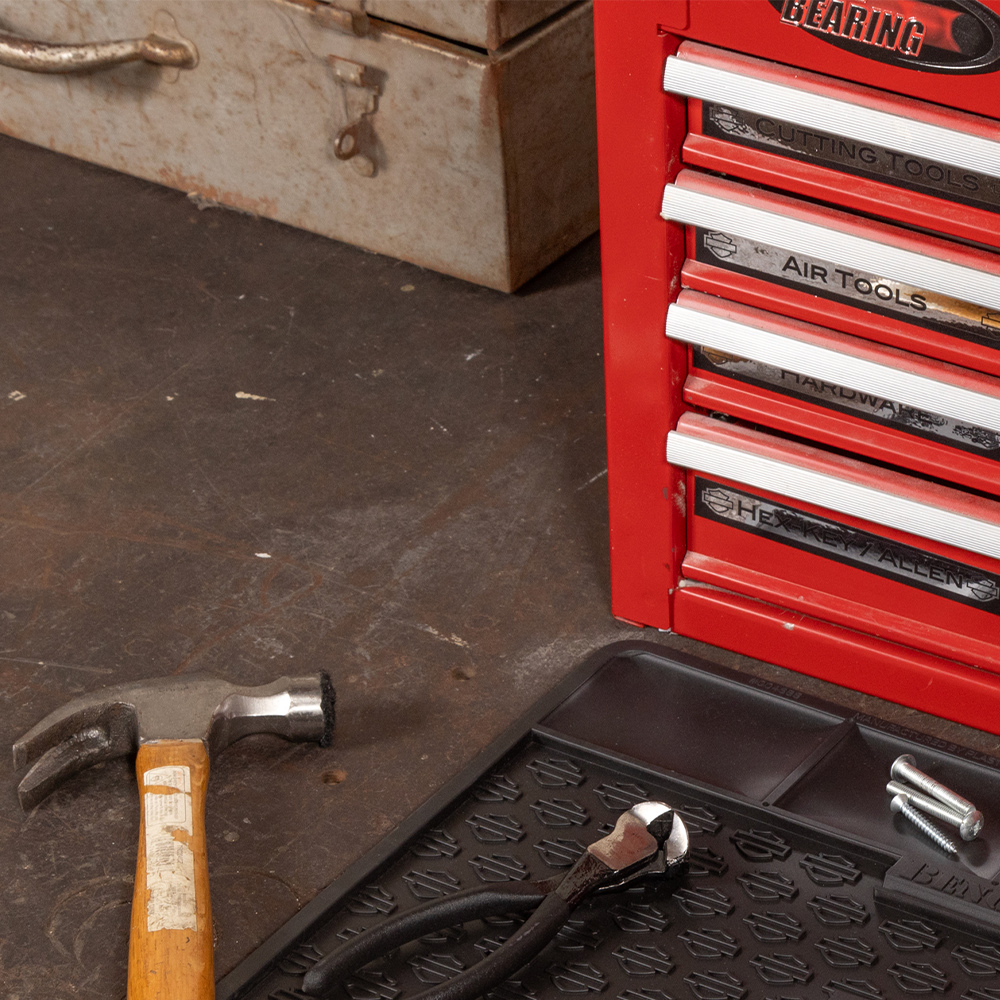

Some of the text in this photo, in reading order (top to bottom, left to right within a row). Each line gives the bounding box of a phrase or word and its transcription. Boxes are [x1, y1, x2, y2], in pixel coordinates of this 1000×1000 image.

[780, 0, 926, 57] BEARING
[756, 117, 979, 192] CUTTING TOOLS
[782, 256, 927, 312] AIR TOOLS
[737, 502, 856, 552] HEX-KEY
[877, 552, 964, 588] ALLEN
[853, 711, 947, 749] MANUFACTURED
